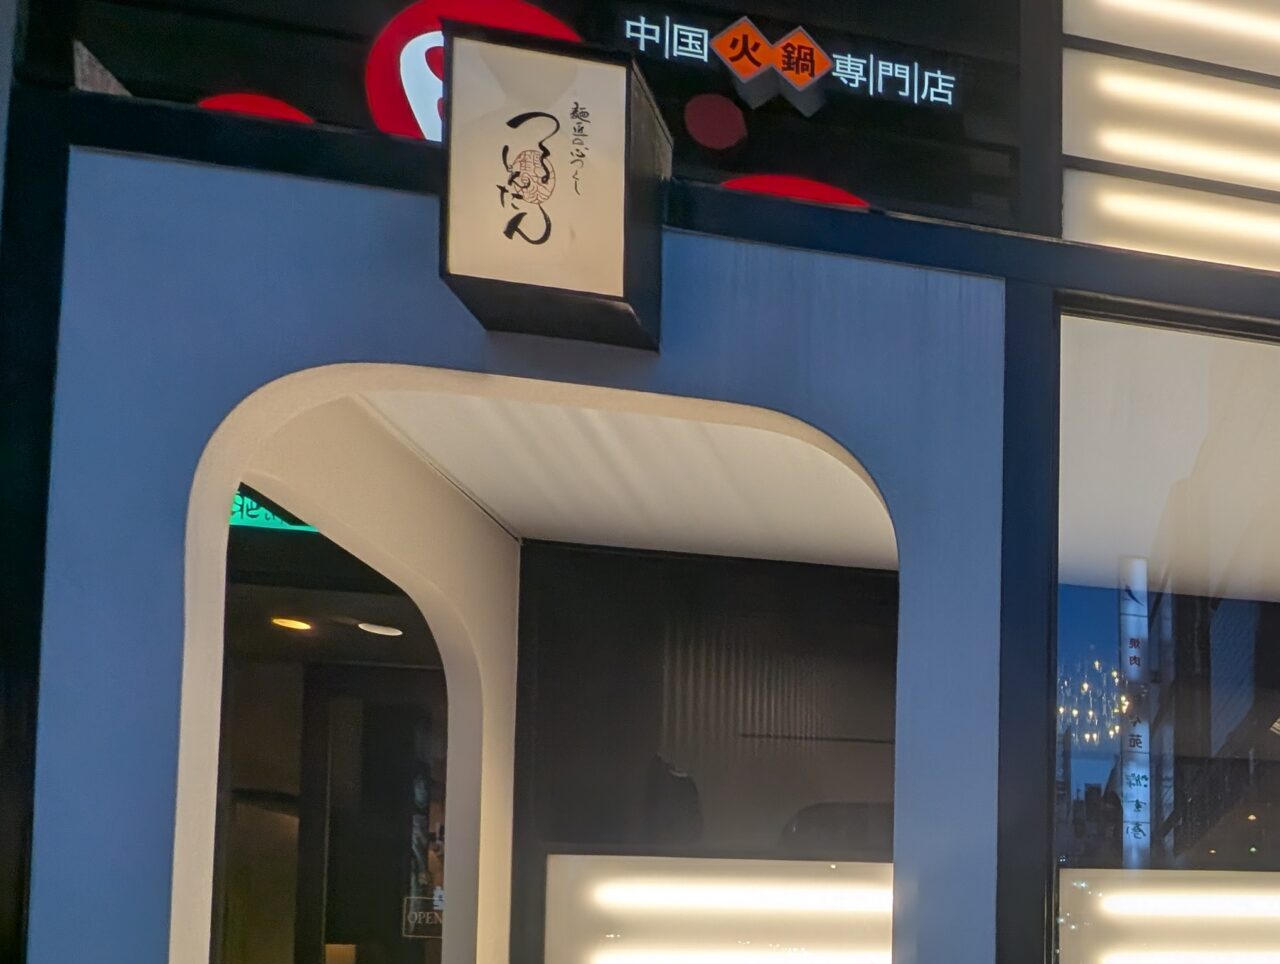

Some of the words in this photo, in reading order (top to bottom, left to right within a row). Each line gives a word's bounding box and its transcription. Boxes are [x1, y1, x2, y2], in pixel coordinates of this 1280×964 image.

[496, 111, 561, 246] つるとんたん
[406, 910, 443, 925] OPEN
